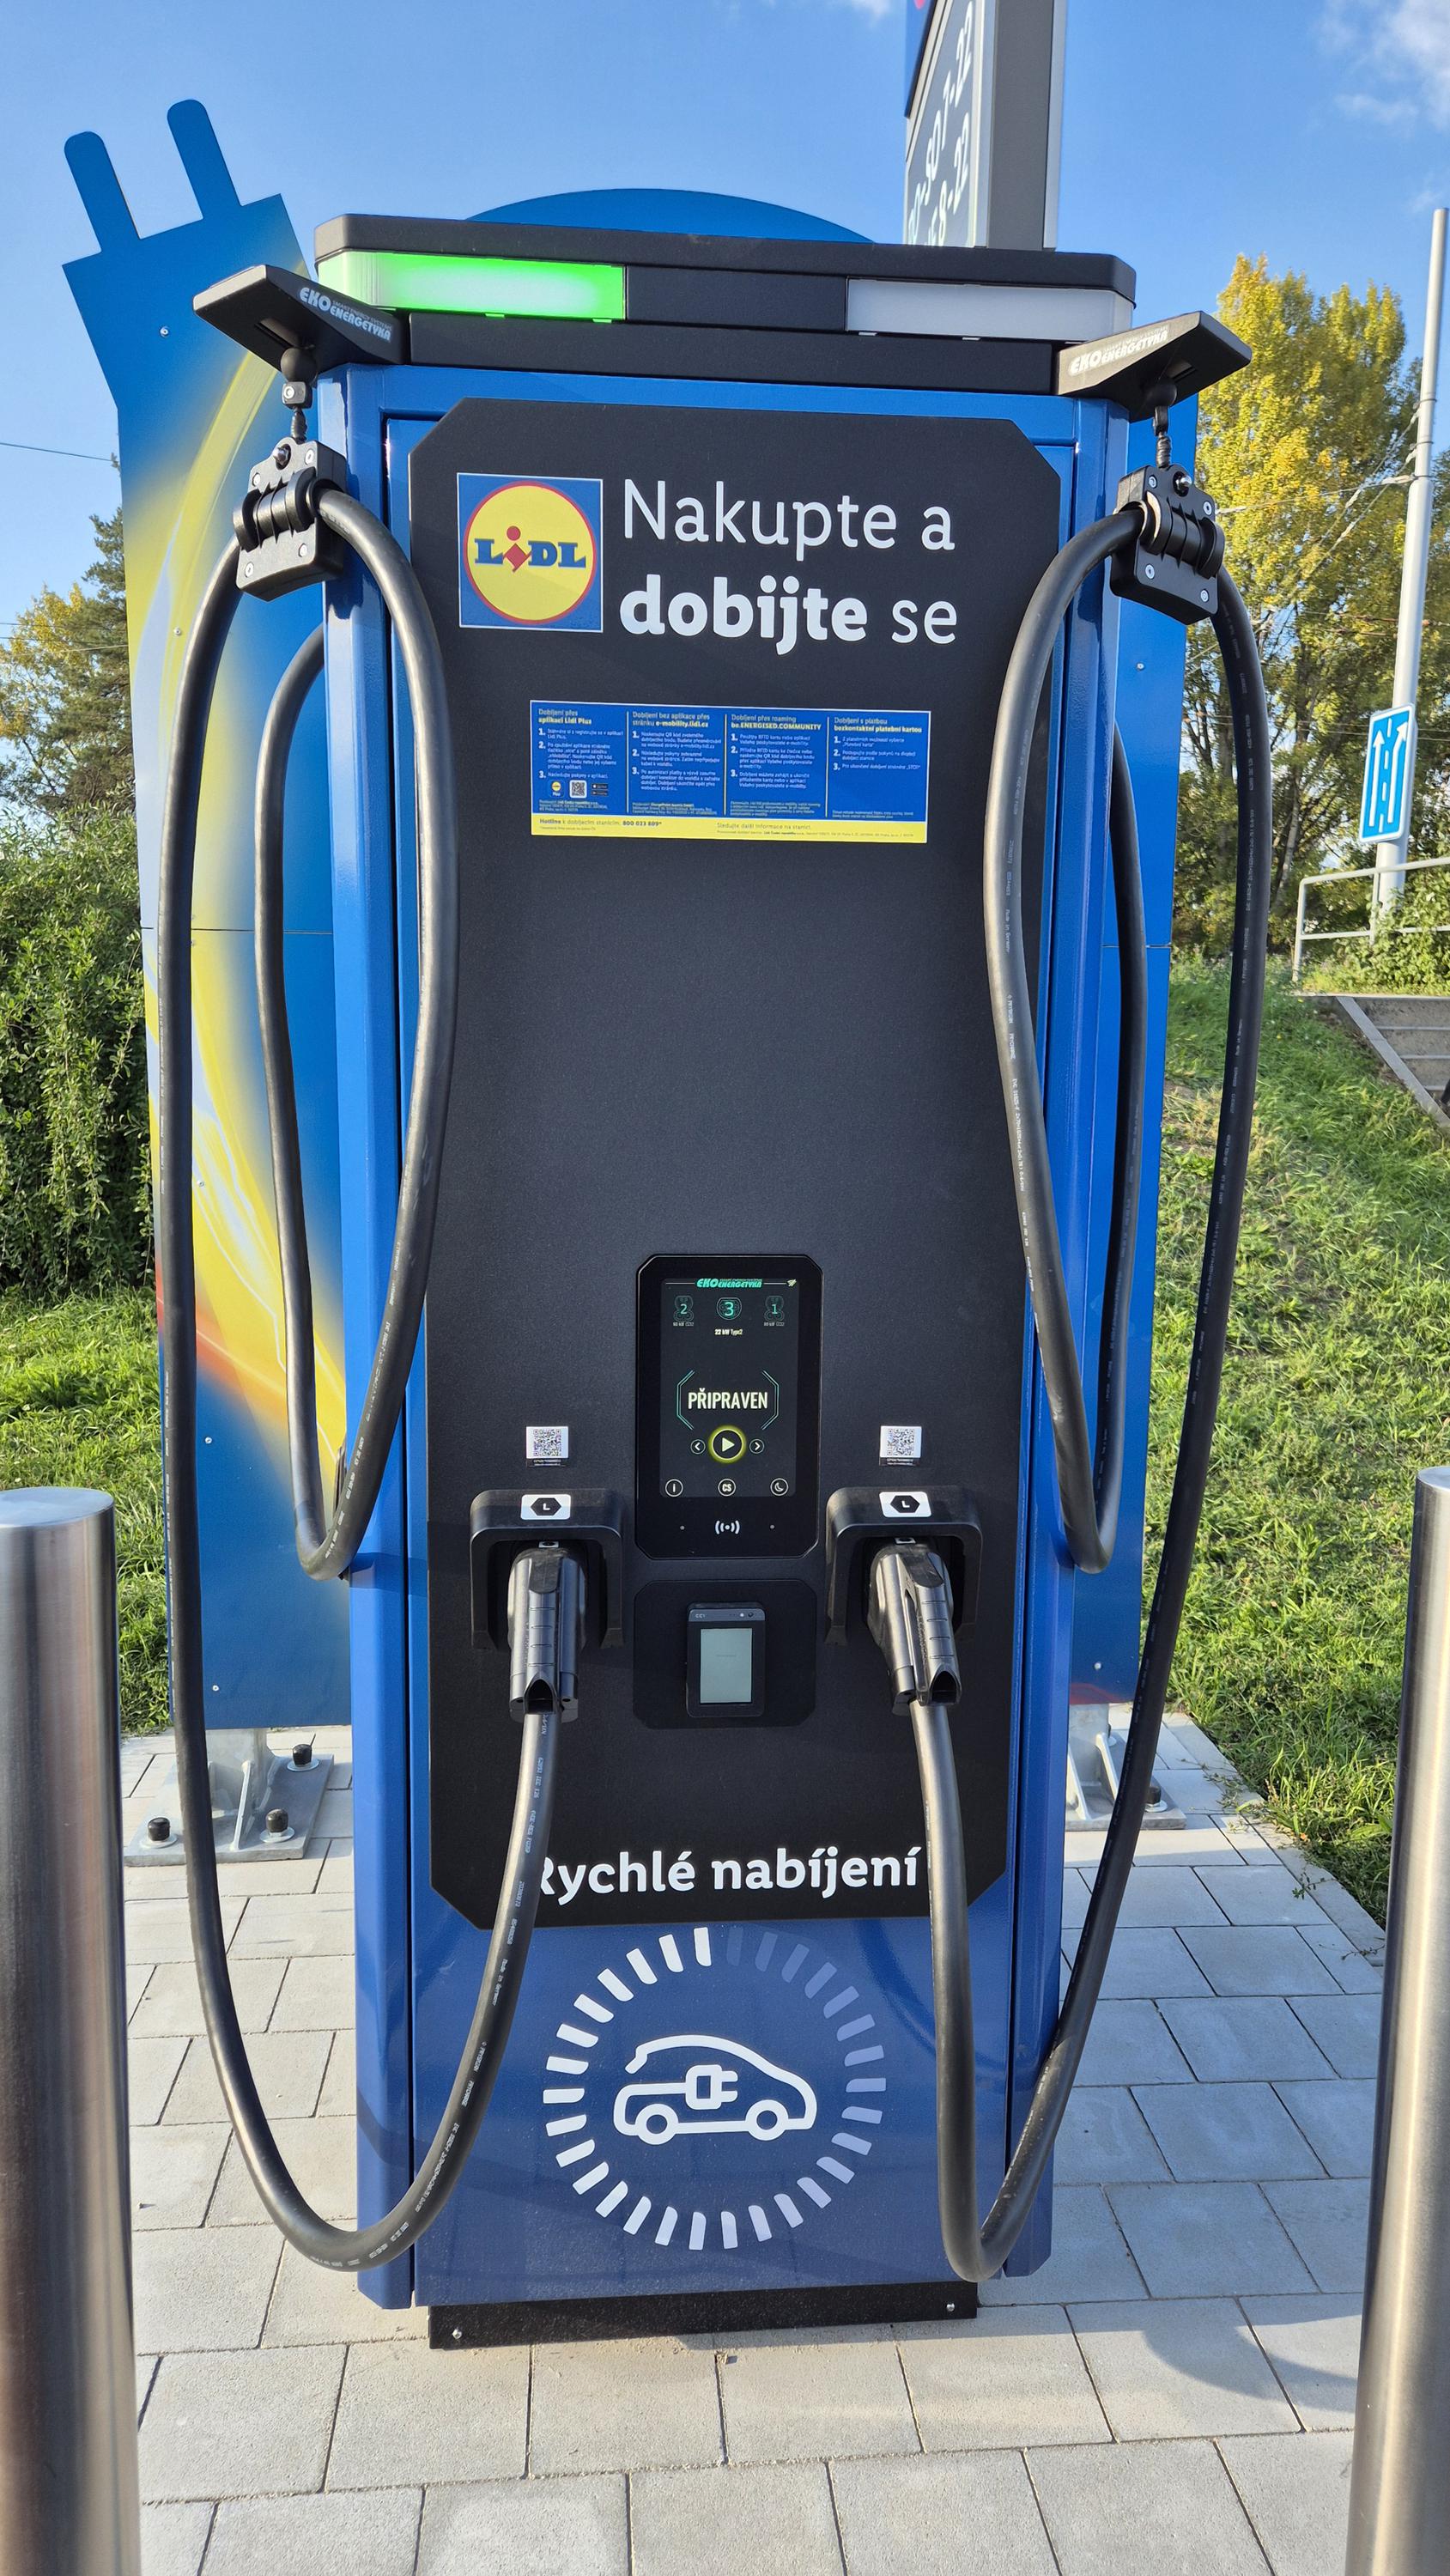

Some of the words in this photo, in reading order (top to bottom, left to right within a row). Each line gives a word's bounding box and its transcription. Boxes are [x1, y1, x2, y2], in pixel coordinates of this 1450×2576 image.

[624, 478, 897, 562] Nakupte
[921, 505, 956, 550] a
[619, 573, 868, 655] dobijte
[892, 599, 958, 643] se
[680, 1303, 688, 1315] 2
[725, 1302, 734, 1315] 3
[772, 1303, 778, 1315] 1
[688, 1388, 768, 1409] PŘIPRAVEN
[722, 1483, 732, 1492] CS
[711, 1846, 922, 1899] nabíjení
